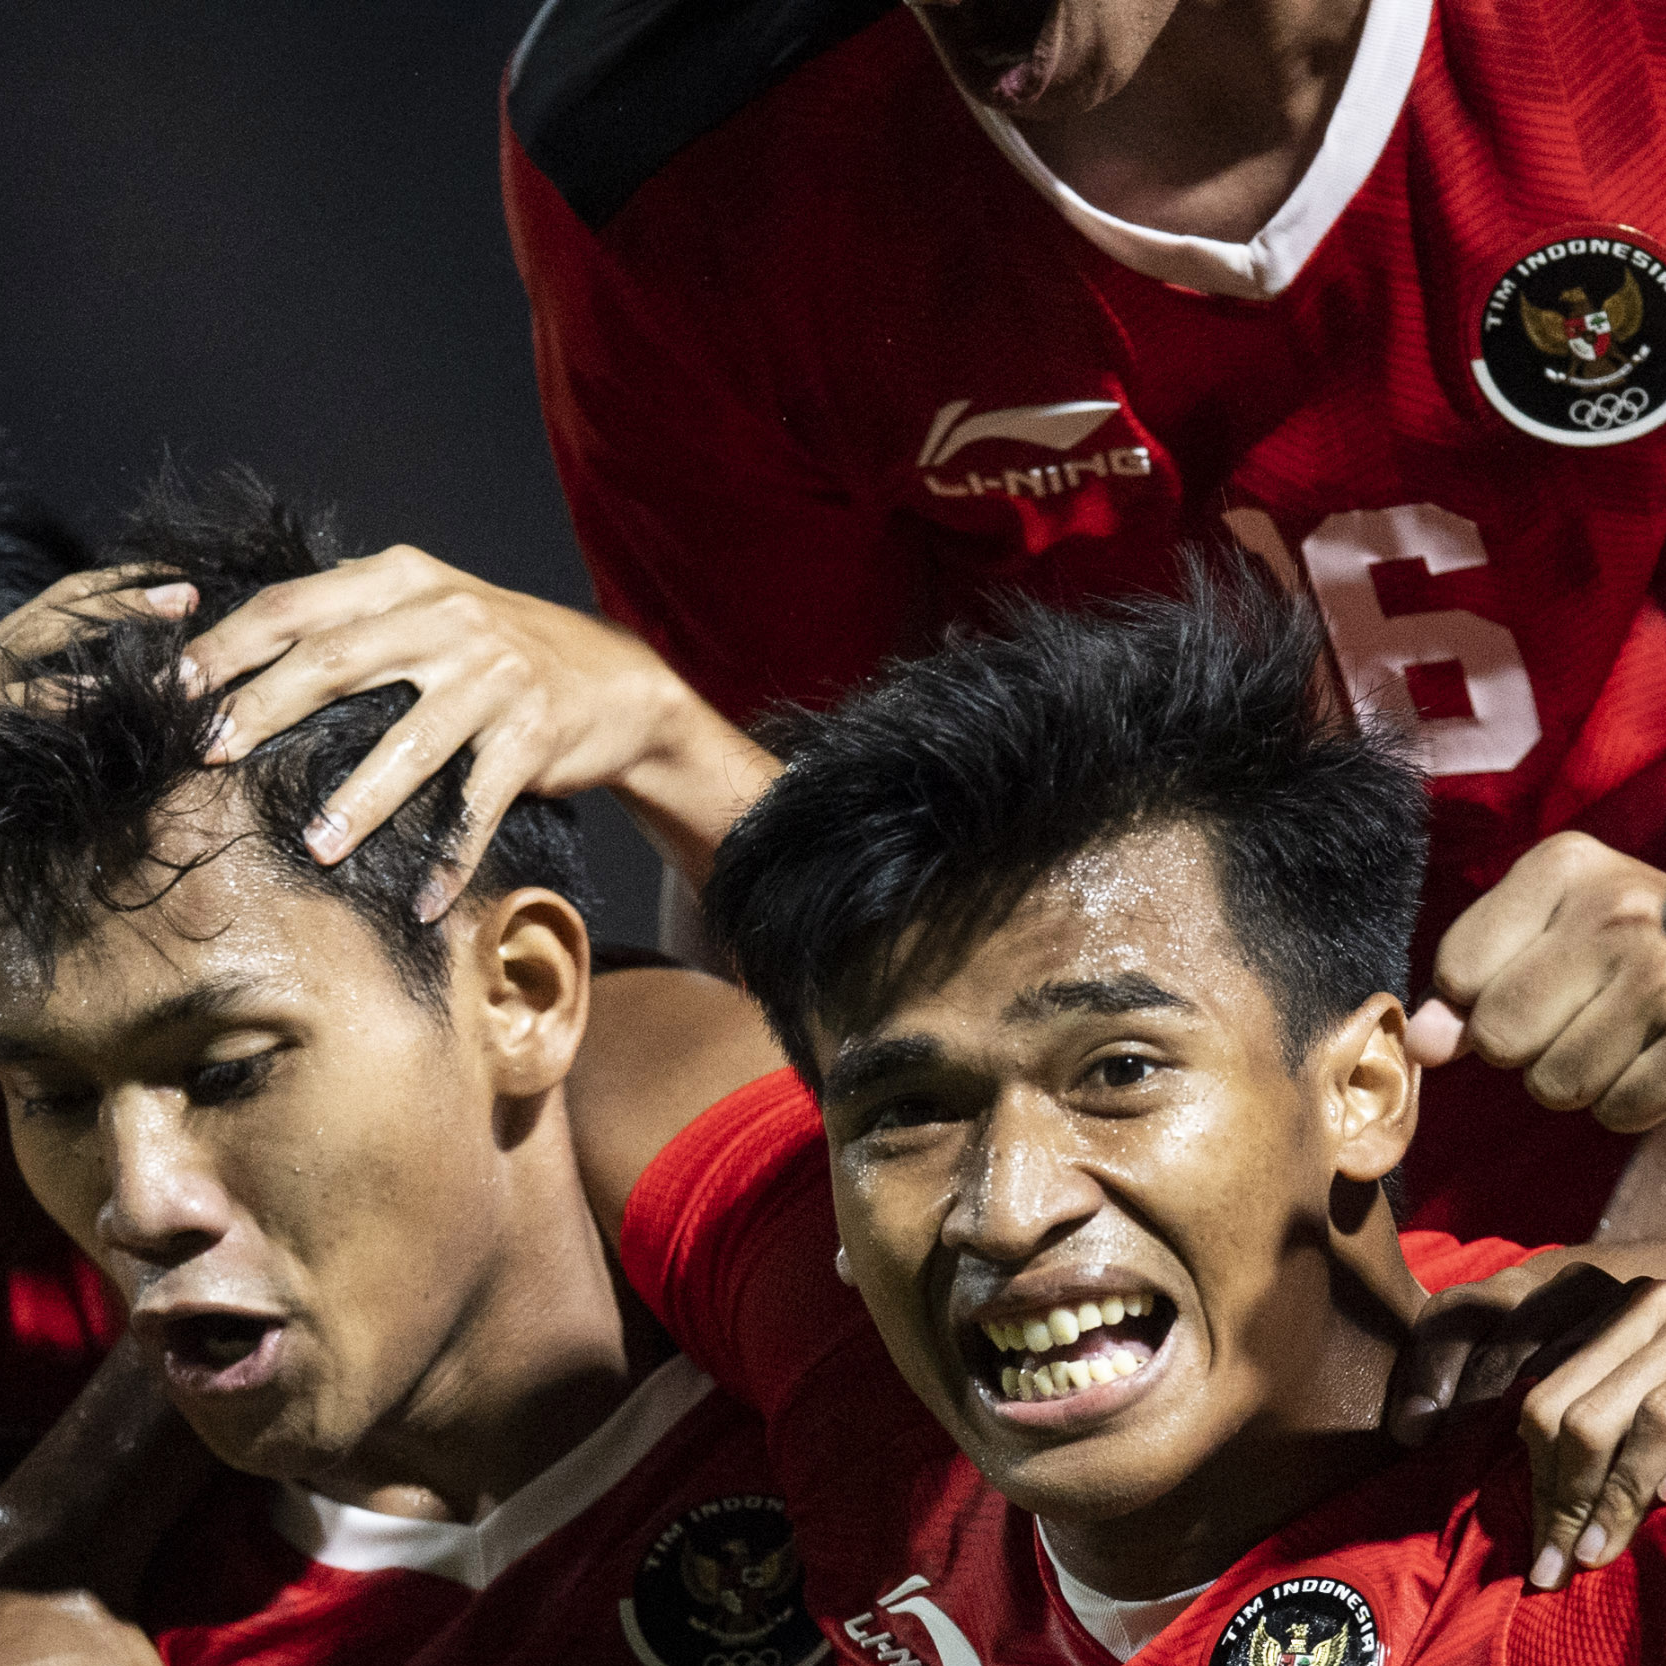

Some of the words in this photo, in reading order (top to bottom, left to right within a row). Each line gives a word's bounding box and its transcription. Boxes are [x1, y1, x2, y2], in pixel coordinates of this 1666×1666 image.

[1485, 278, 1517, 332] TIM
[924, 446, 1152, 498] LI-NING
[642, 1522, 684, 1571] TIM
[689, 1495, 784, 1523] INDON
[1221, 1596, 1265, 1646] TIM
[1272, 1579, 1376, 1653] INDONESIA
